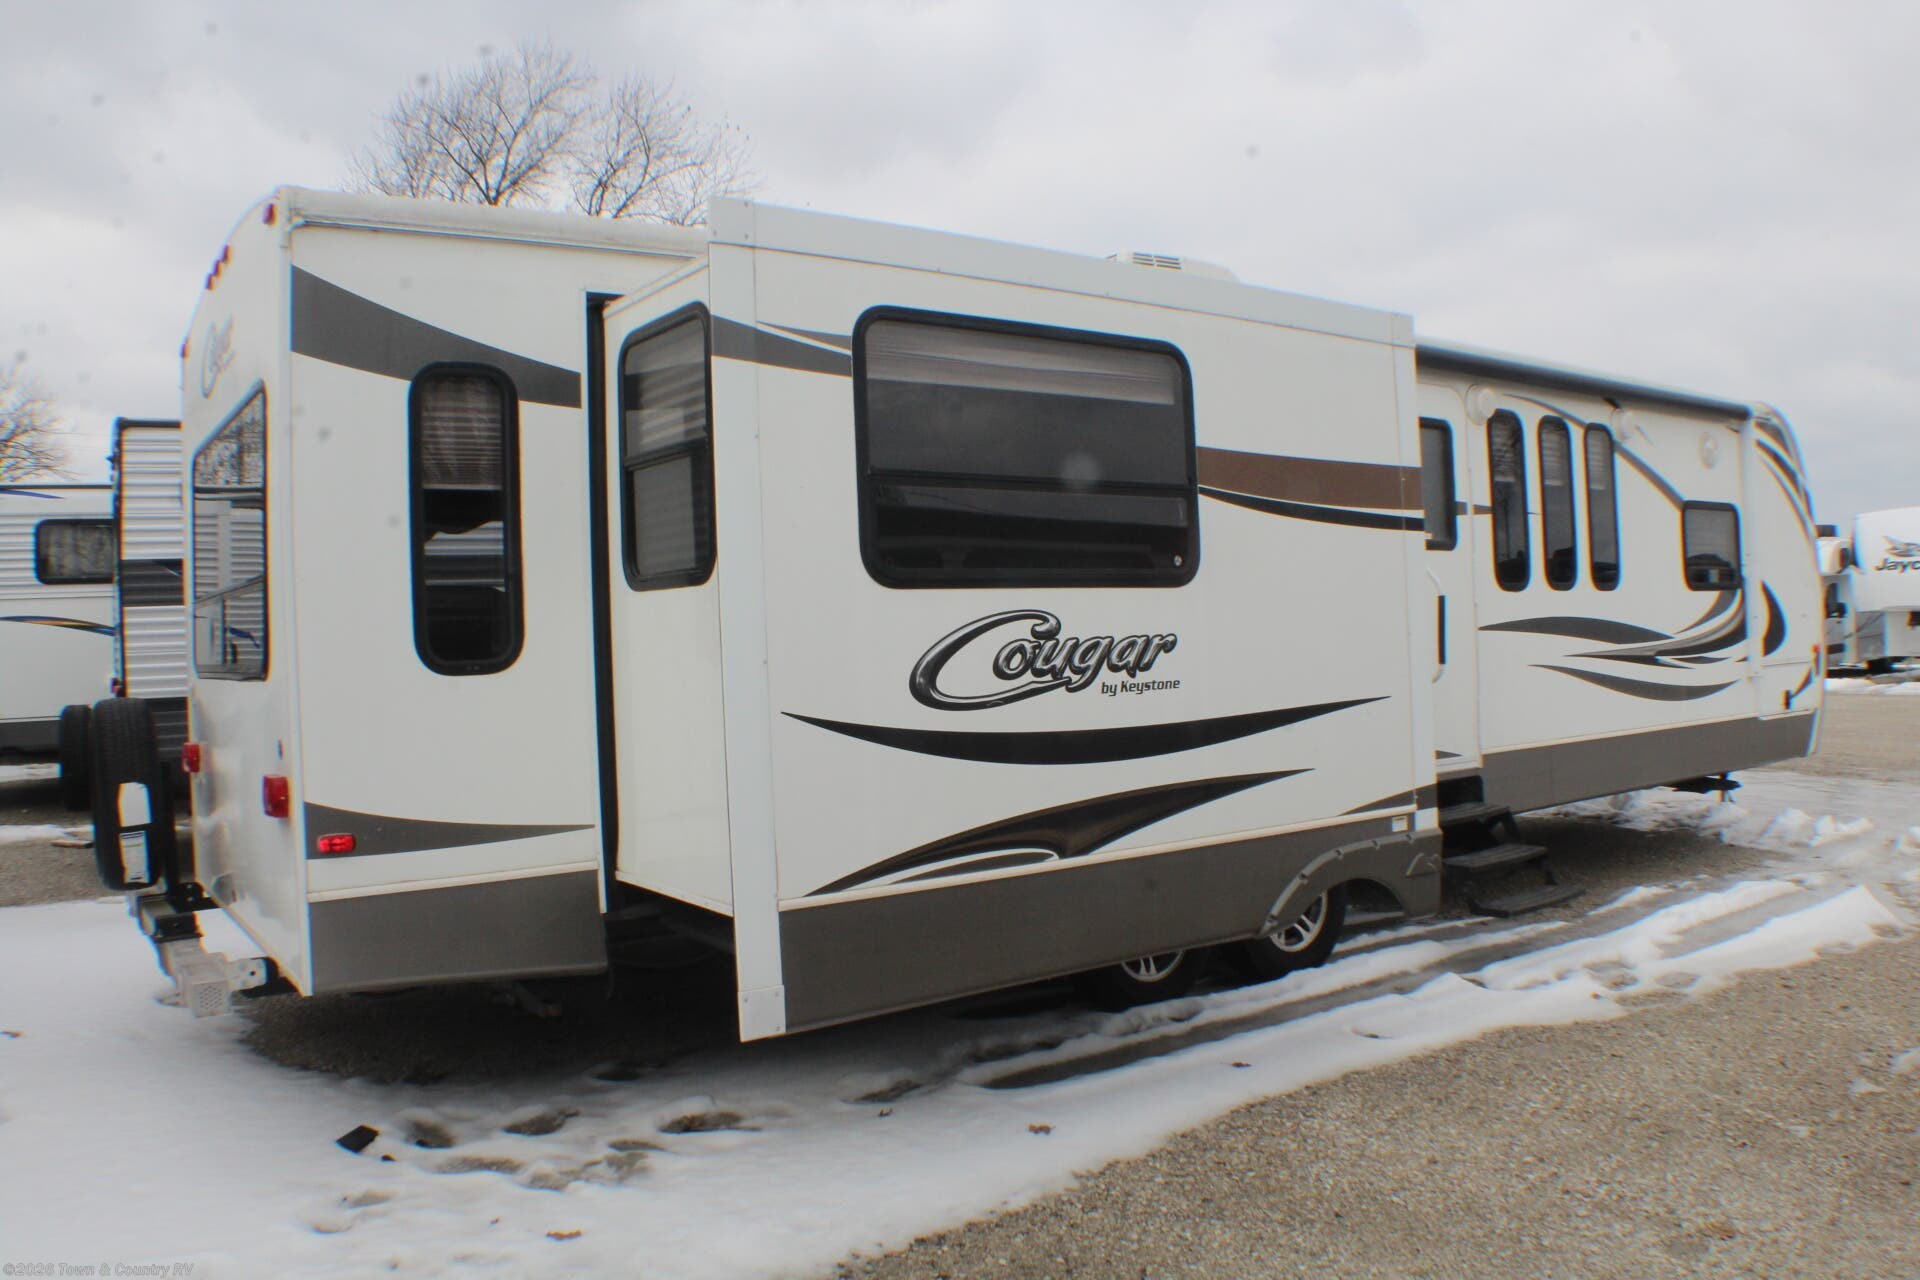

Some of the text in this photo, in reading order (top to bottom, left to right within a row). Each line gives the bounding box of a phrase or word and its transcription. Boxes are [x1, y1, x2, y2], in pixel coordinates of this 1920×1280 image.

[908, 608, 1178, 711] Cougar
[1101, 679, 1181, 697] by Keystone
